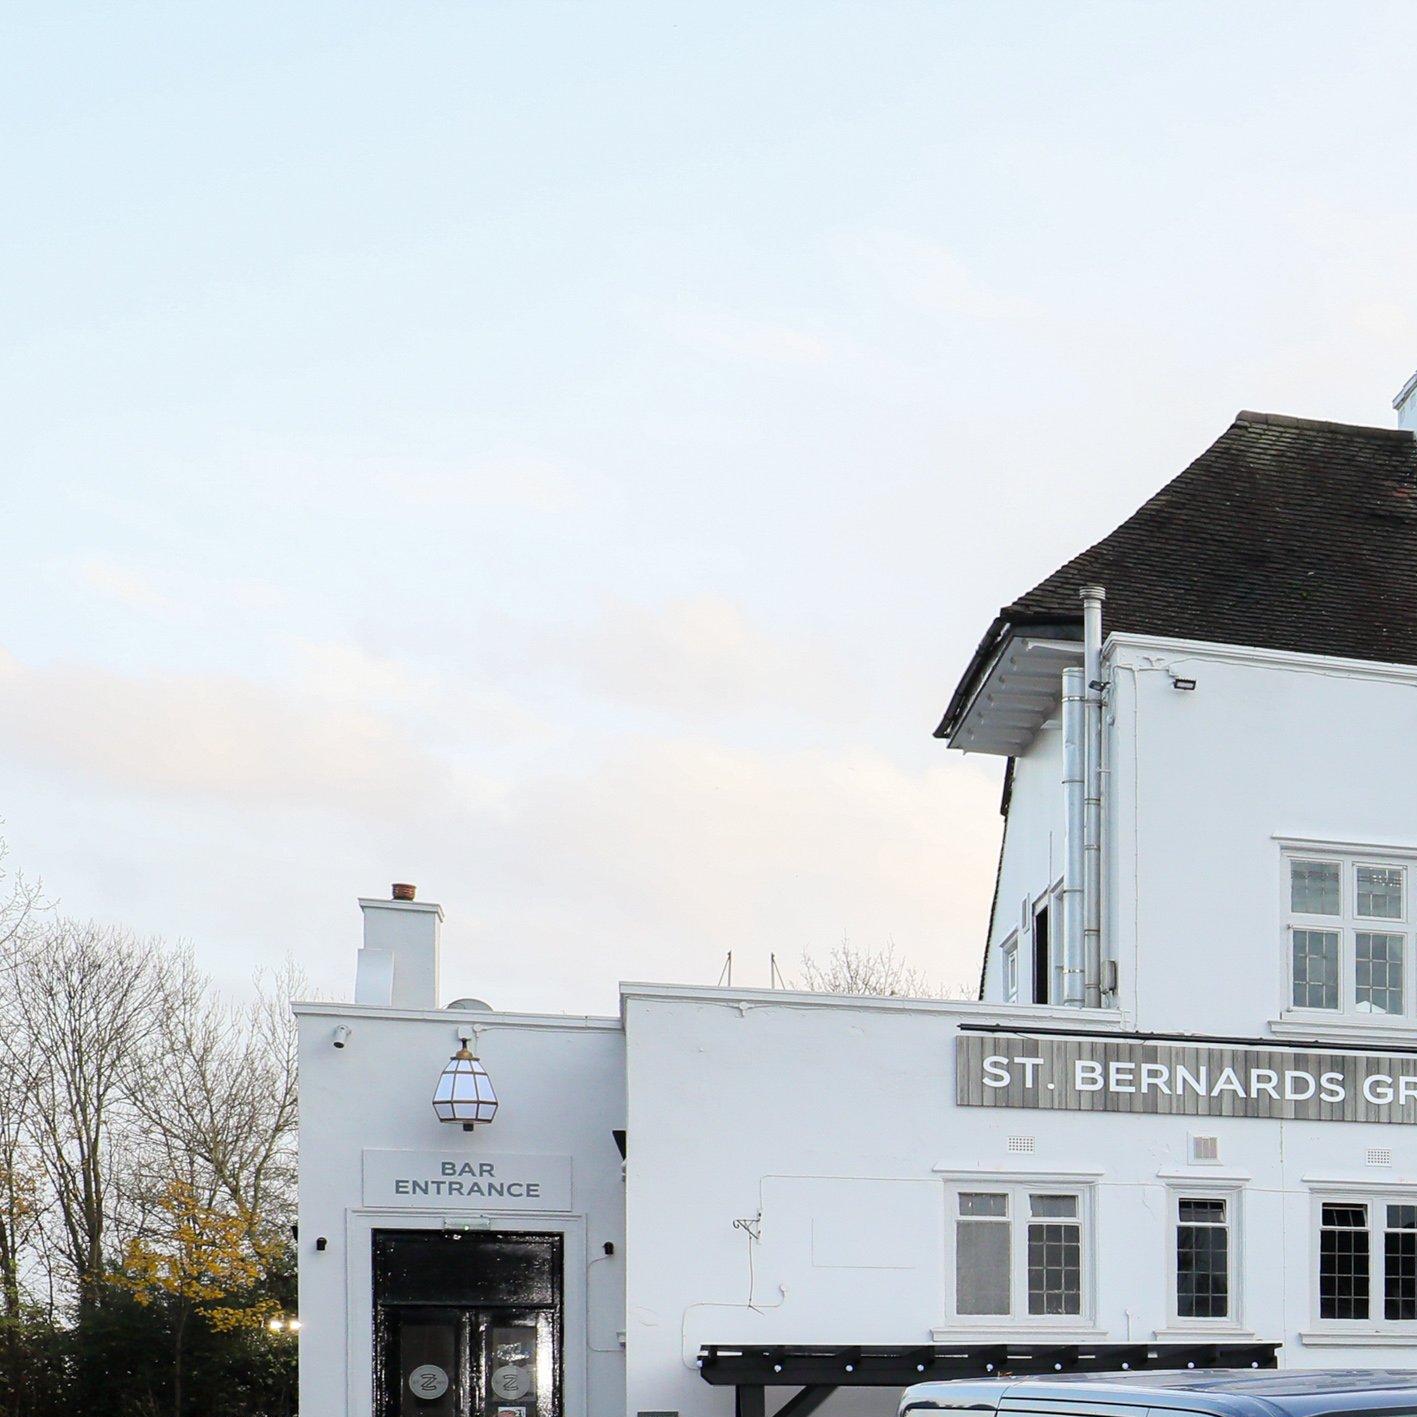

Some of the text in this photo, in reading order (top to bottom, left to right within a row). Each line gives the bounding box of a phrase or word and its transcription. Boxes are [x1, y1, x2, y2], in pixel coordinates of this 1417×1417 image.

[982, 1055, 1055, 1091] ST.
[1074, 1060, 1346, 1104] BERNARDS
[441, 1161, 496, 1178] BAR
[395, 1179, 541, 1198] ENTRANCE
